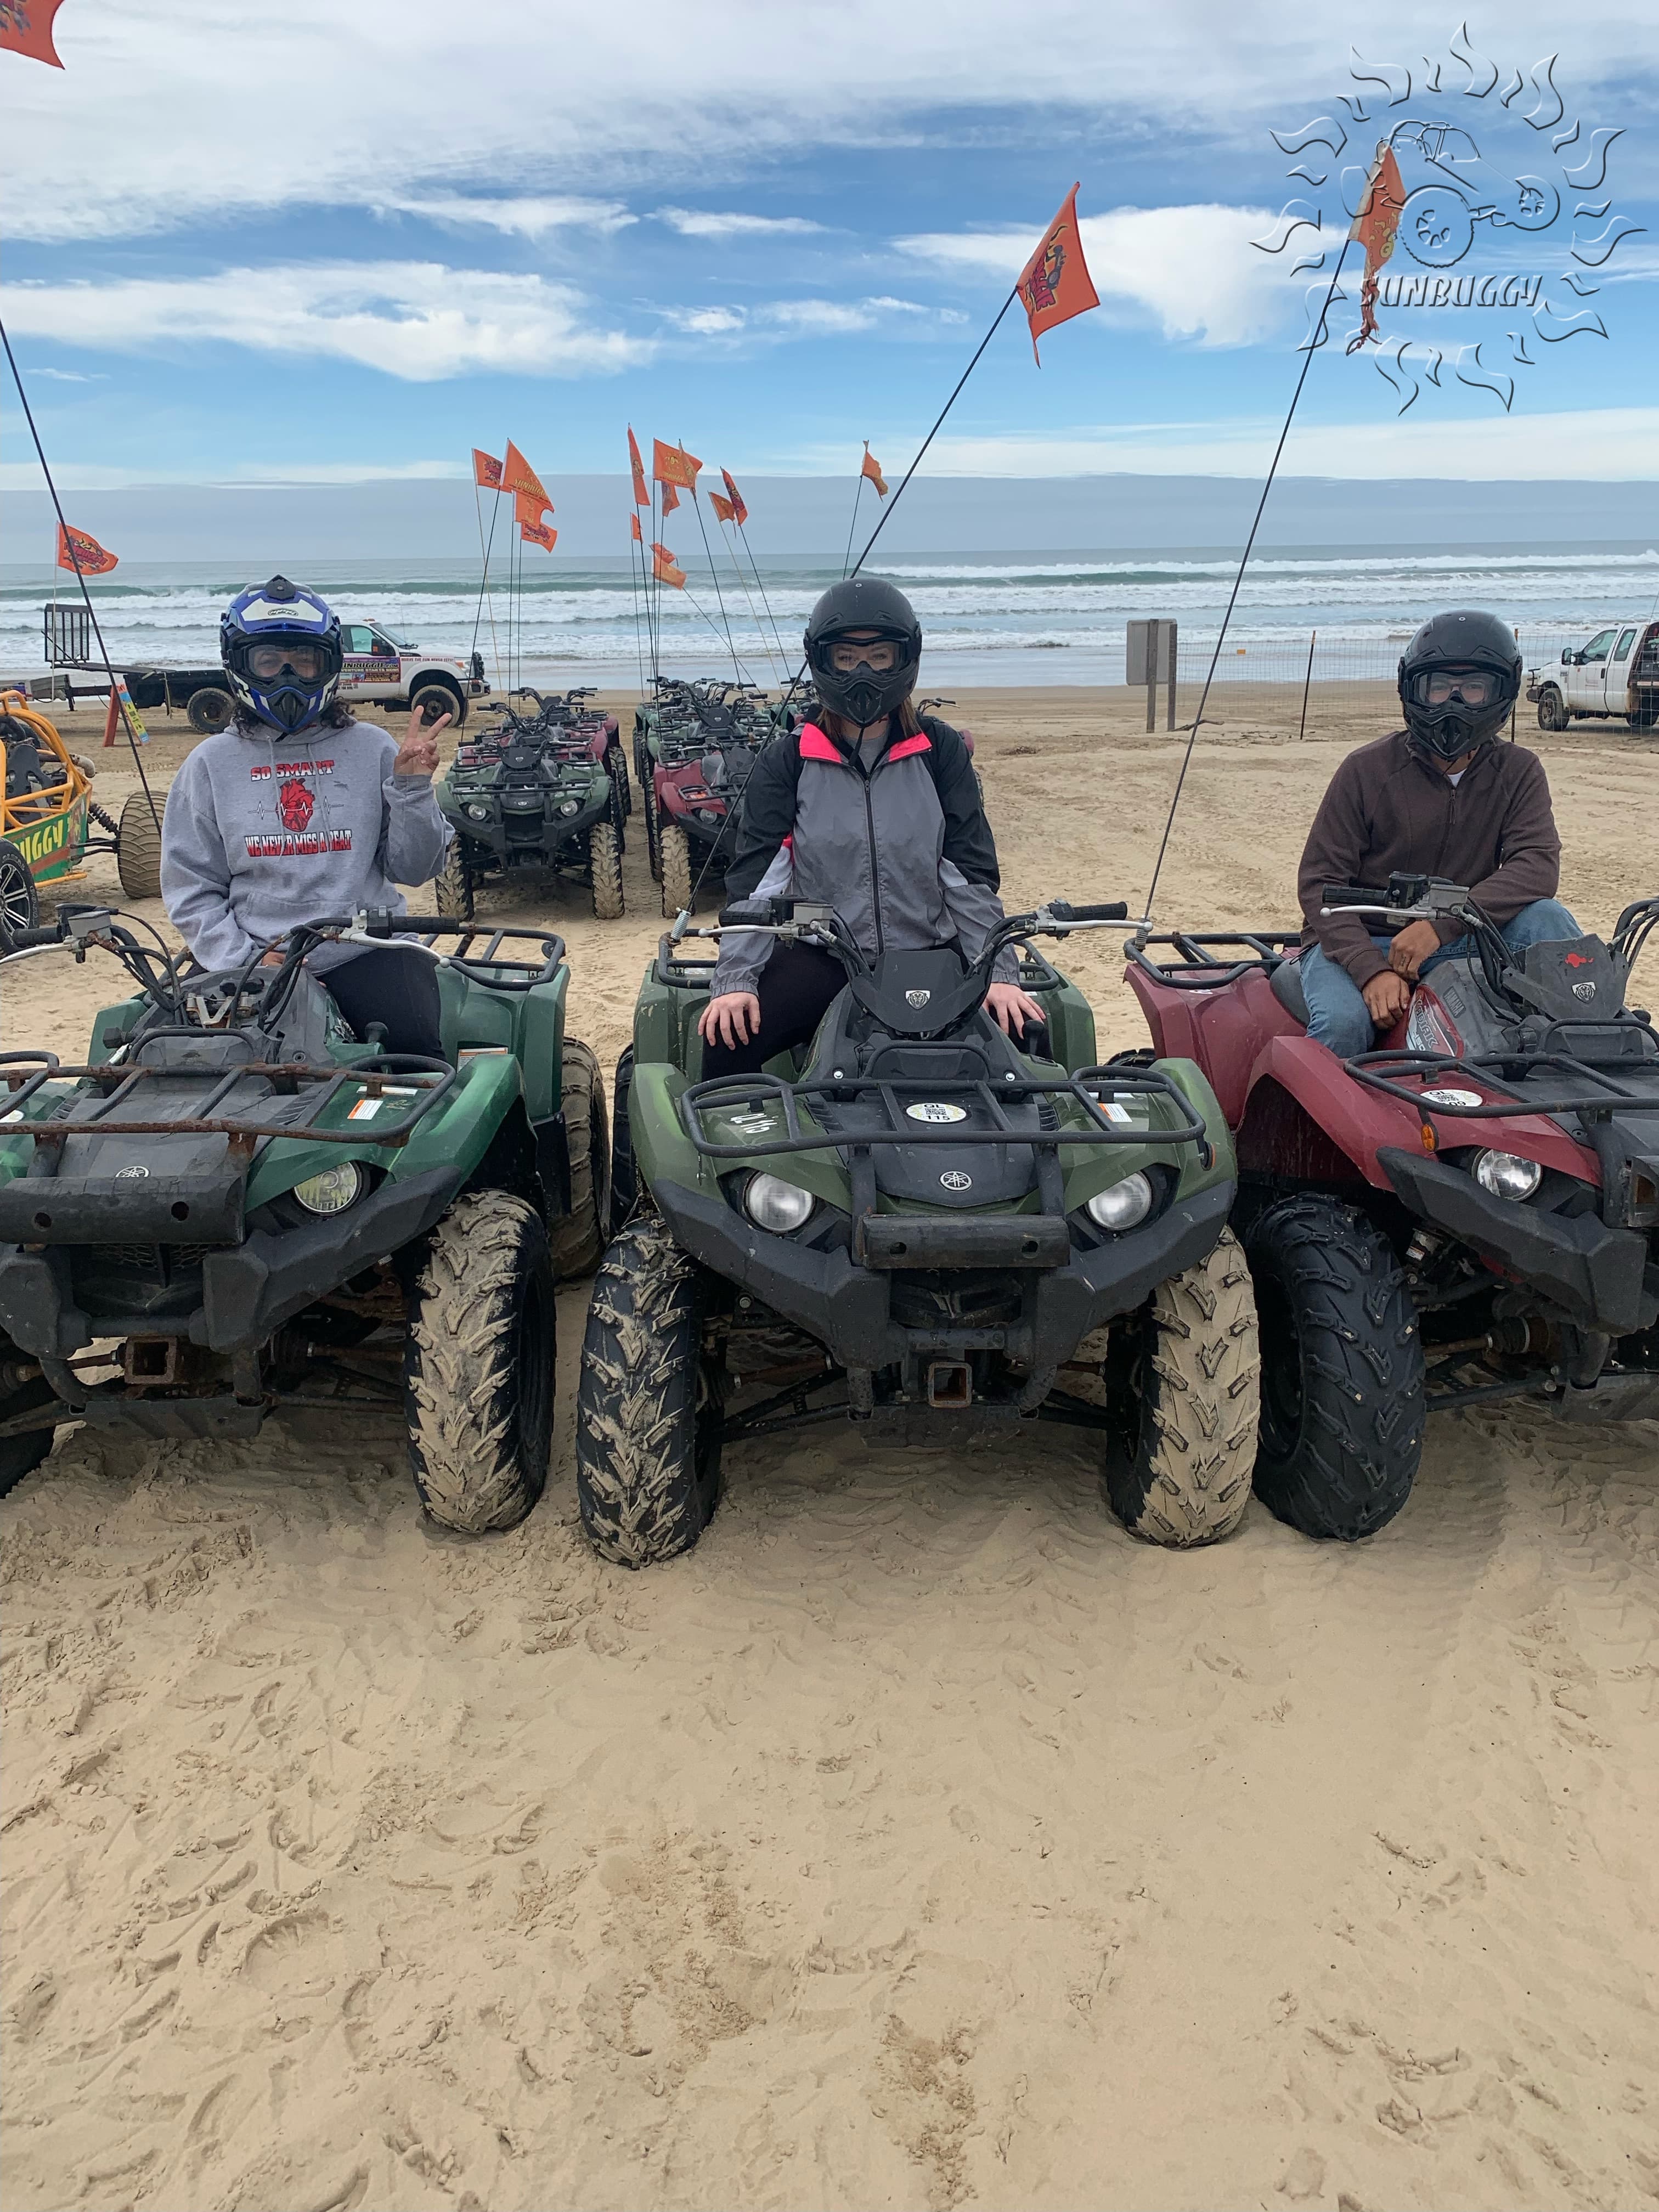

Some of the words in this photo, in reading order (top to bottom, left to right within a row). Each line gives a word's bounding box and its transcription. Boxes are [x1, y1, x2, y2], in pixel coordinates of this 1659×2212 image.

[514, 477, 547, 497] SUNBUGG
[251, 766, 272, 781] SO
[275, 760, 335, 778] SMART
[13, 820, 64, 864] UGGY
[245, 836, 262, 857] WE
[261, 834, 295, 856] NEVER
[294, 832, 319, 855] MISS
[317, 831, 328, 853] A
[1443, 986, 1464, 1017] YAMAHA
[1414, 996, 1440, 1048] KODIAK
[1413, 1031, 1426, 1051] 450
